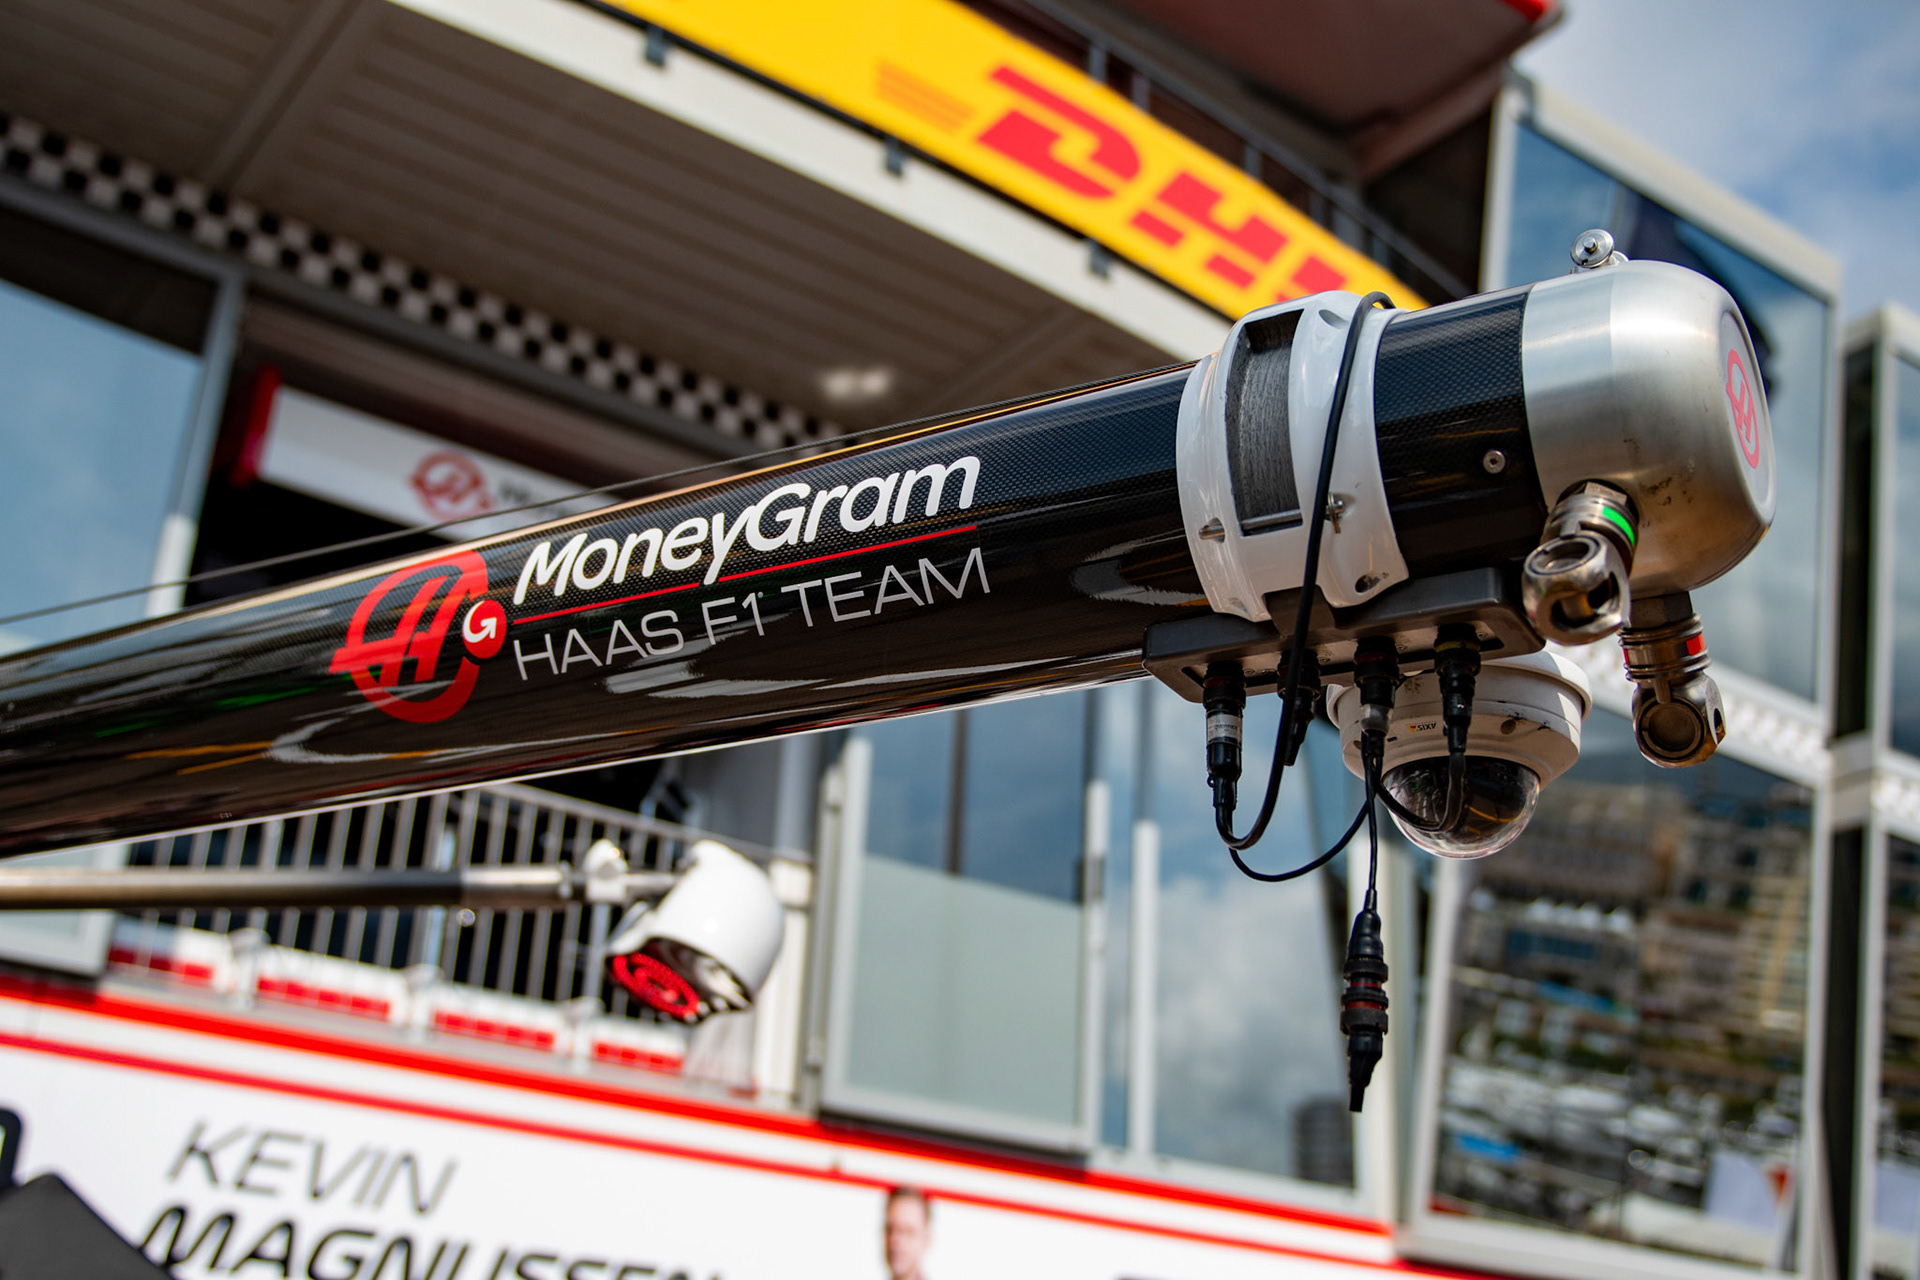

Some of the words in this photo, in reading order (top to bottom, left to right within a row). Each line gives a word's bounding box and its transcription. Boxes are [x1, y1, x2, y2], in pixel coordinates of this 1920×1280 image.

[513, 456, 981, 605] MoneyGram
[513, 609, 684, 681] HAAS
[780, 546, 990, 628] TEAM
[166, 1121, 459, 1213] KEVIN
